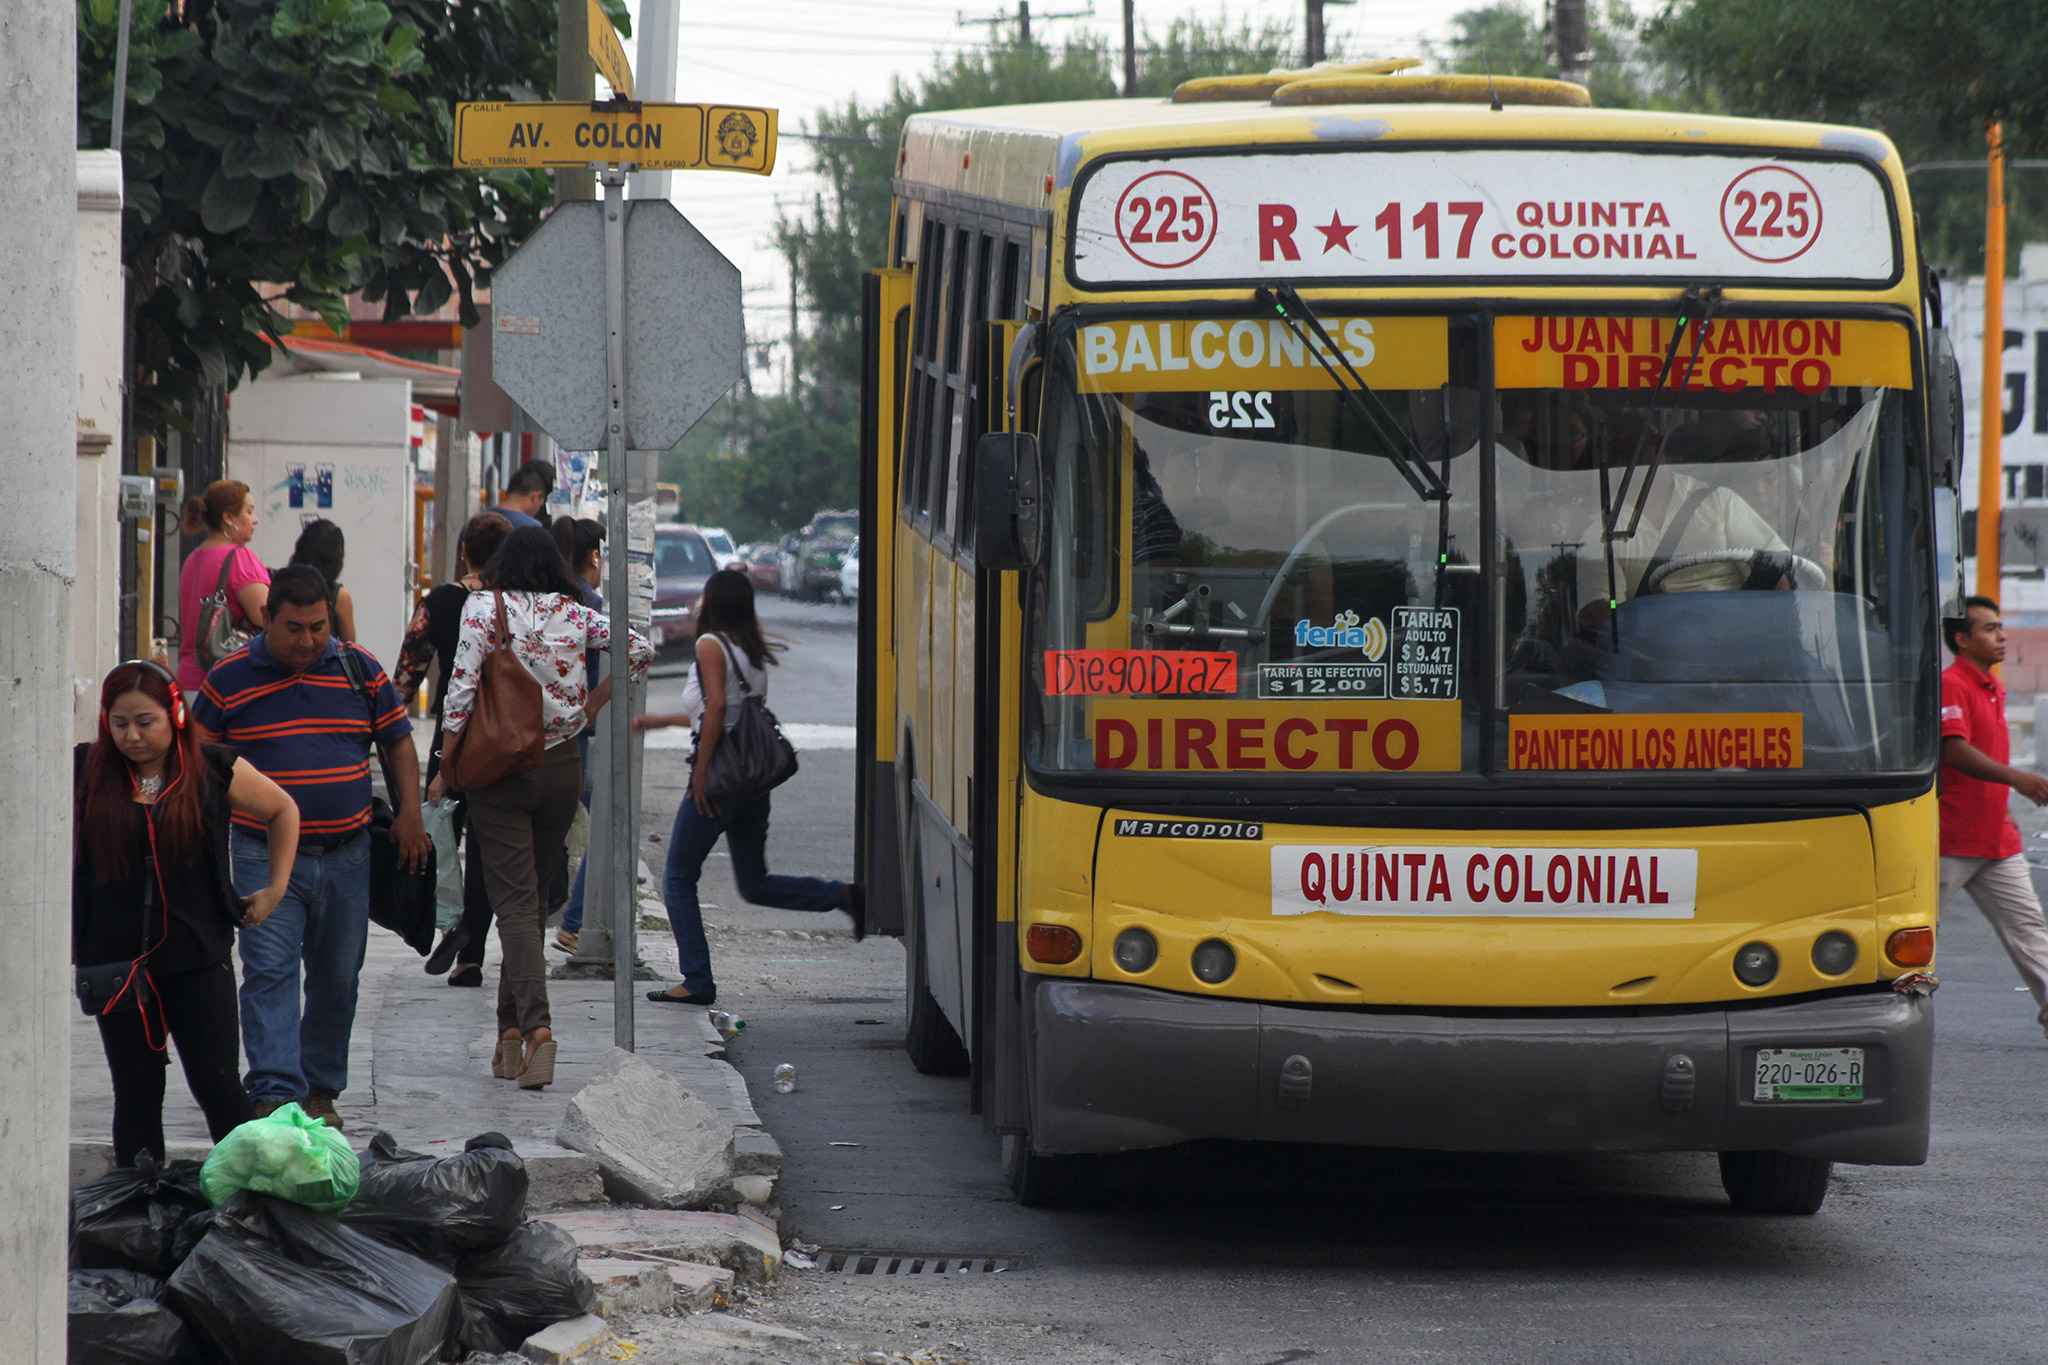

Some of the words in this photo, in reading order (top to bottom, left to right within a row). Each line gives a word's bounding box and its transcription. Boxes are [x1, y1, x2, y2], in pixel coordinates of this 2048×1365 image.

[473, 104, 501, 112] CALLE
[509, 122, 550, 148] AV.
[574, 122, 662, 150] COLON
[488, 157, 528, 165] TERMINAL
[1129, 196, 1204, 244] 225
[1516, 201, 1671, 228] QUINTA
[1733, 191, 1810, 238] 225
[1258, 204, 1302, 262] R
[1375, 201, 1484, 260] 117
[1491, 234, 1697, 260] COLONIAL
[1084, 319, 1376, 375] BALCONES
[1521, 316, 1635, 355] JUAN
[1700, 320, 1842, 357] RAMON
[1562, 354, 1832, 396] DIRECTO
[1296, 619, 1366, 646] feria
[1399, 611, 1453, 628] TARIFA
[1405, 631, 1447, 642] ADULTO
[1264, 668, 1302, 678] TARIFA
[1307, 668, 1322, 678] EN
[1326, 667, 1382, 678] EFECTIVO
[1396, 662, 1453, 675] ESTUDIANTE
[1095, 718, 1419, 770] DIRECTO
[1514, 729, 1623, 769] PANTEON
[1632, 728, 1675, 769] LOS
[1684, 727, 1792, 769] ANGELES
[1118, 820, 1259, 838] Marcopolo
[1301, 852, 1452, 903] QUINTA
[1466, 853, 1669, 903] COLONIAL
[1758, 1062, 1861, 1084] 220-026-R
